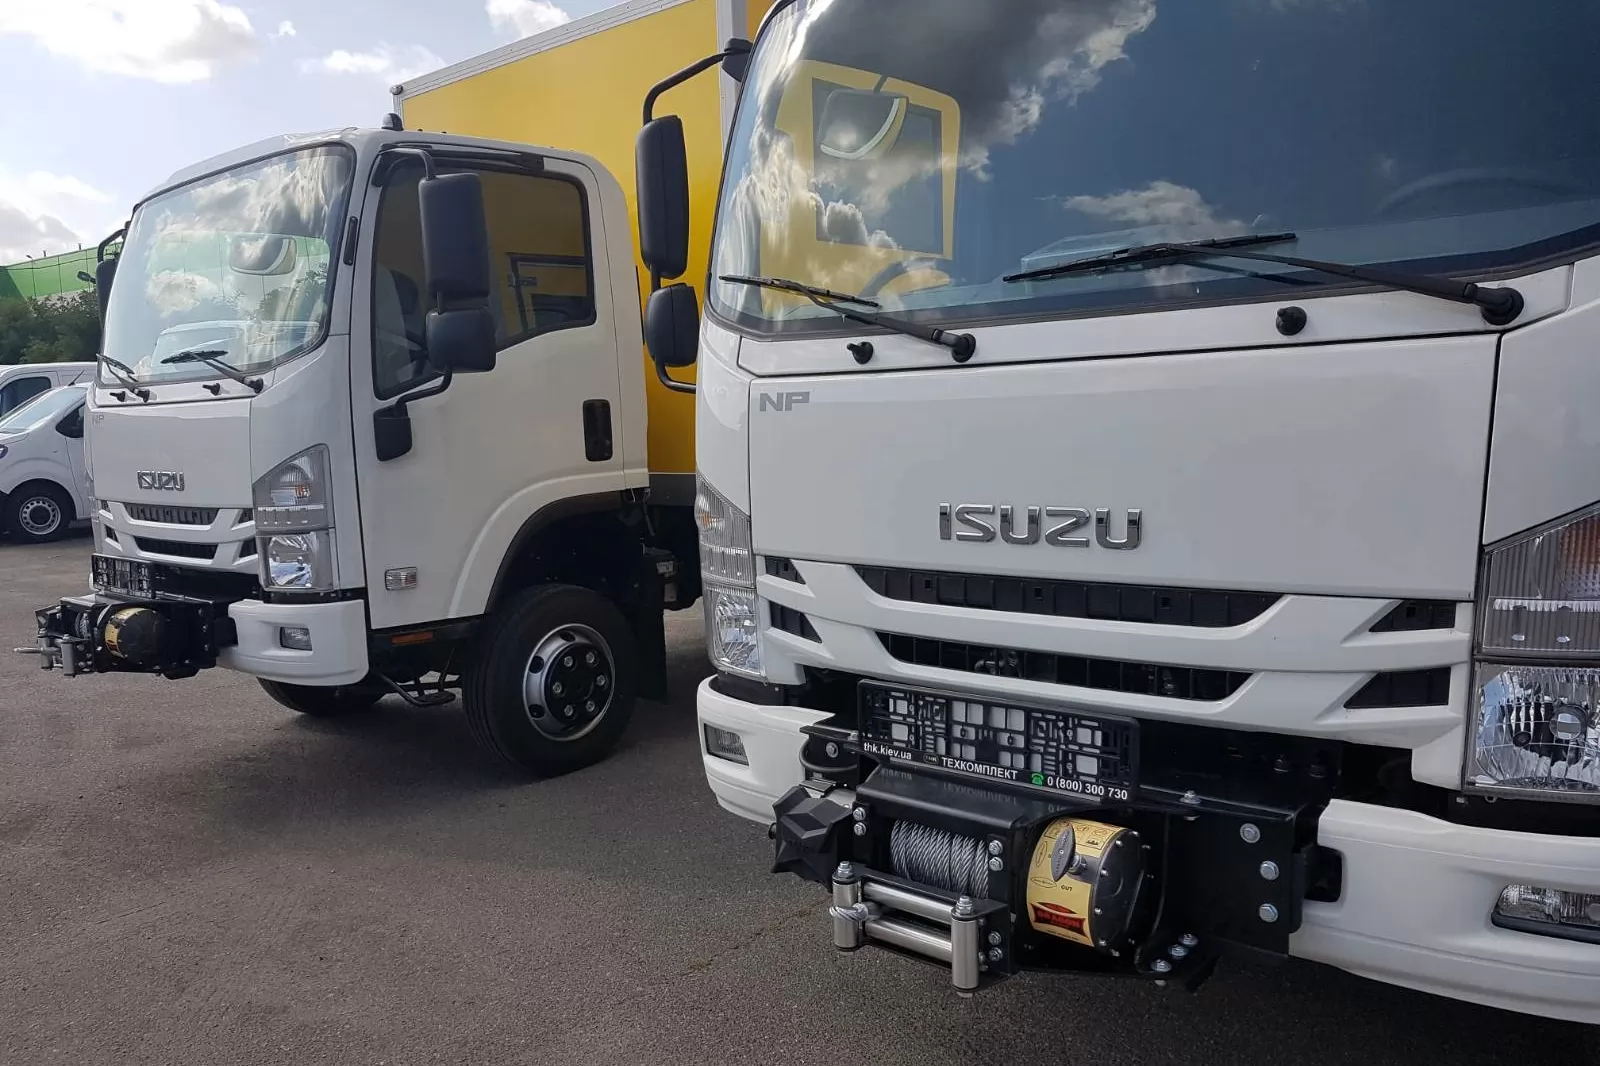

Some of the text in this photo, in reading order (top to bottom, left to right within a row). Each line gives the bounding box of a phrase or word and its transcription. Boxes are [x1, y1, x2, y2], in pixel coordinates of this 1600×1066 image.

[760, 391, 810, 412] NP
[137, 470, 185, 491] ISUZU
[939, 502, 1142, 550] ISUZU
[863, 742, 912, 760] thk.kiev.ua
[941, 756, 1018, 780] ТЕХКОМПЛЕКТ
[1047, 776, 1128, 800] 0 (800) 300 730
